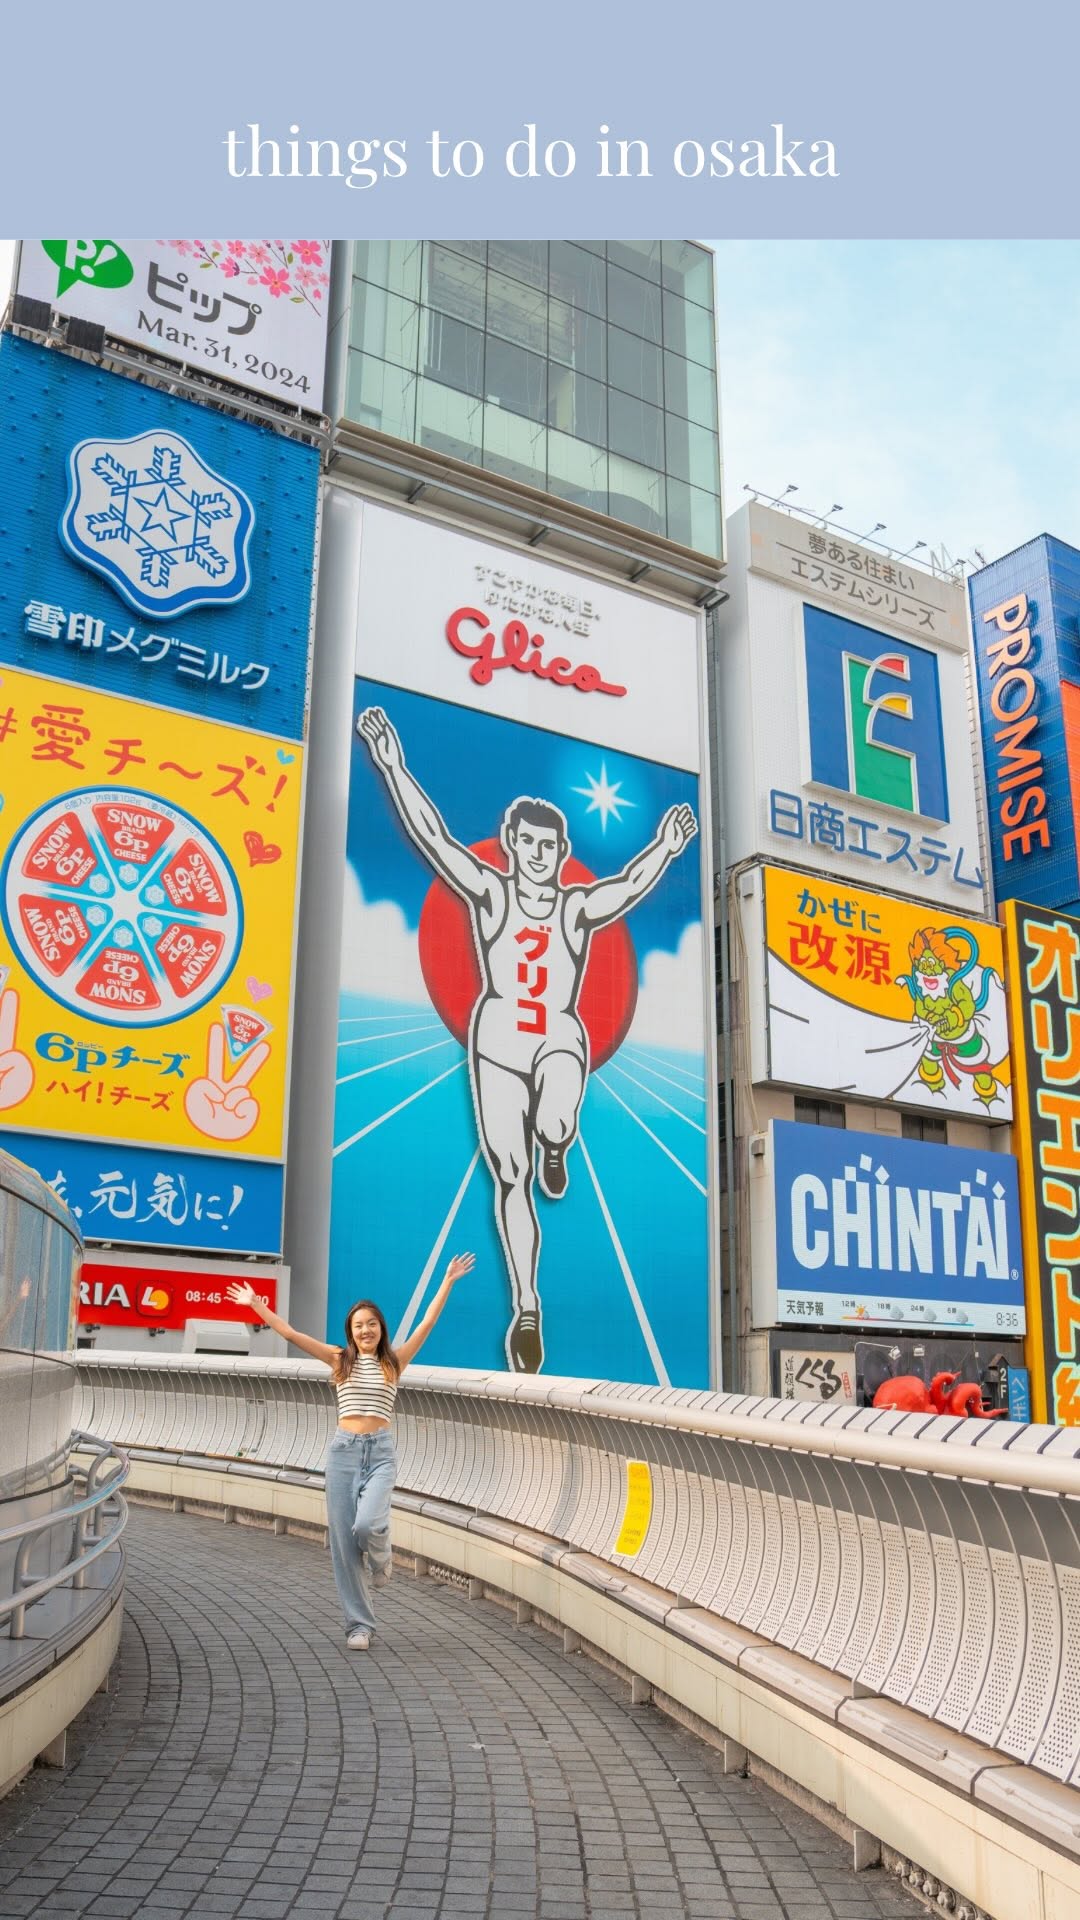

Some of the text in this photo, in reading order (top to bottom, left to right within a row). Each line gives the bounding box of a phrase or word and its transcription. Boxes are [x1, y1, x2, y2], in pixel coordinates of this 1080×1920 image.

[147, 261, 263, 335] ピップ
[137, 308, 311, 394] Mar. 31, 2024
[807, 531, 916, 591] 夢ある住まい
[791, 556, 935, 630] エステムシリーズ
[22, 598, 272, 691] 雪印メグミルク
[445, 606, 628, 697] Glico
[982, 592, 1051, 862] PROMISE
[107, 808, 162, 832] SNOW
[769, 788, 984, 890] 日商エステム
[32, 821, 73, 870] SNOW
[71, 856, 97, 885] CHEESE
[114, 848, 148, 862] CHEESE
[162, 873, 183, 906] CHEESE
[187, 853, 222, 904] SNOW
[24, 906, 61, 963] SNOW
[68, 905, 89, 940] CHEESE
[797, 887, 882, 935] かぜに
[105, 950, 139, 964] CHEESE
[157, 925, 181, 954] CHEESE
[180, 940, 217, 989] SNOW
[787, 920, 893, 987] 改源
[90, 982, 147, 1005] SNOW
[514, 924, 552, 1035] グリコ
[790, 1154, 1010, 1280] CHINTAI
[786, 1299, 824, 1316] 天気予報
[795, 1357, 843, 1401] くくる
